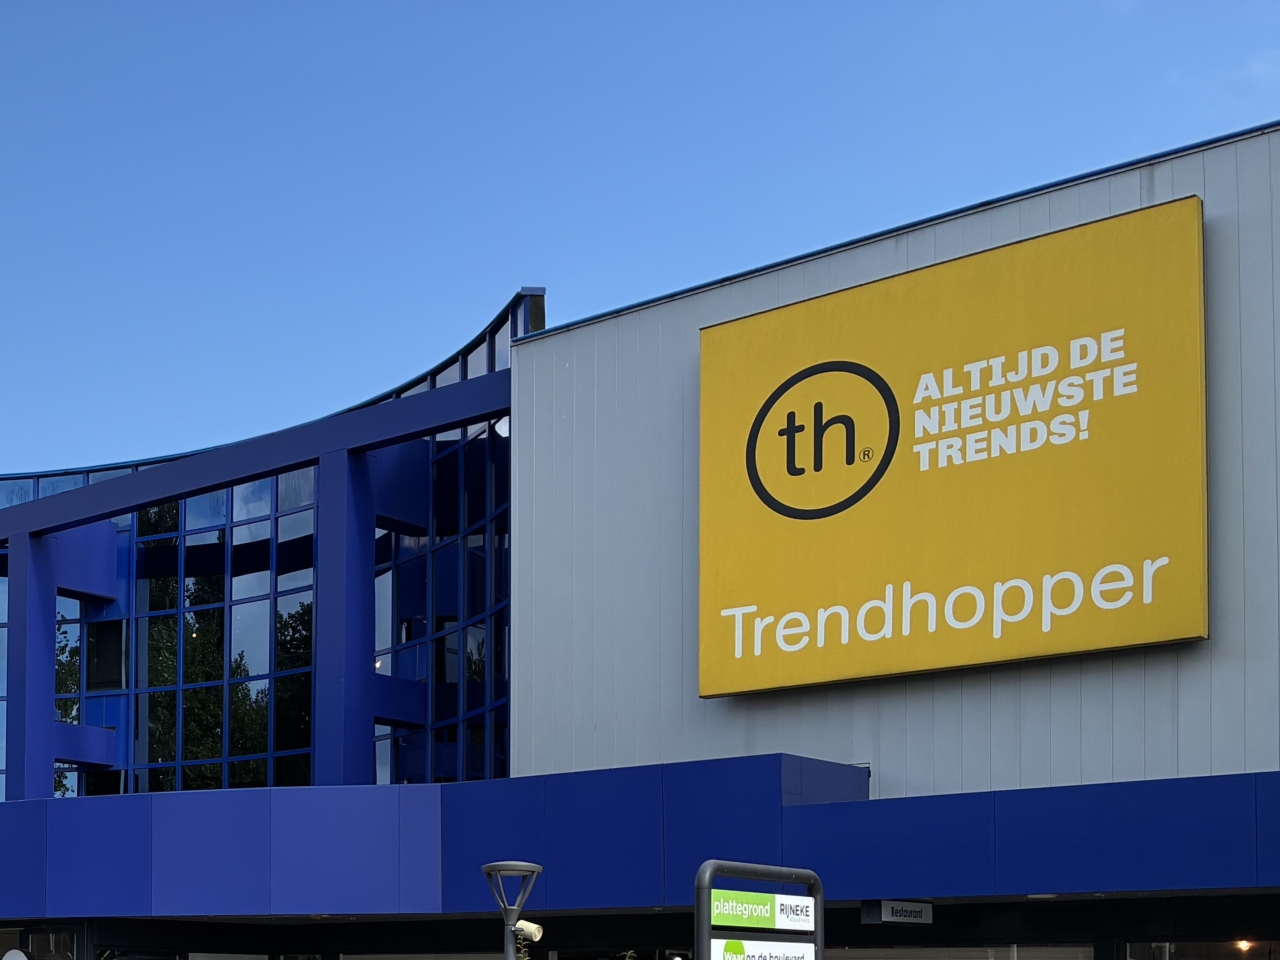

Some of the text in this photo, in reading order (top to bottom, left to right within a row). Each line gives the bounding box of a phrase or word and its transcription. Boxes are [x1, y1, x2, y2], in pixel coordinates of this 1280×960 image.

[913, 328, 1125, 403] ALTIJD DE
[913, 362, 1138, 438] NIEUWSTE
[913, 409, 1090, 472] TRENDS!
[720, 556, 1170, 659] Trendhopper
[713, 898, 771, 919] plattegrond
[779, 903, 810, 918] RIJNEKE
[891, 906, 923, 919] Restaurant
